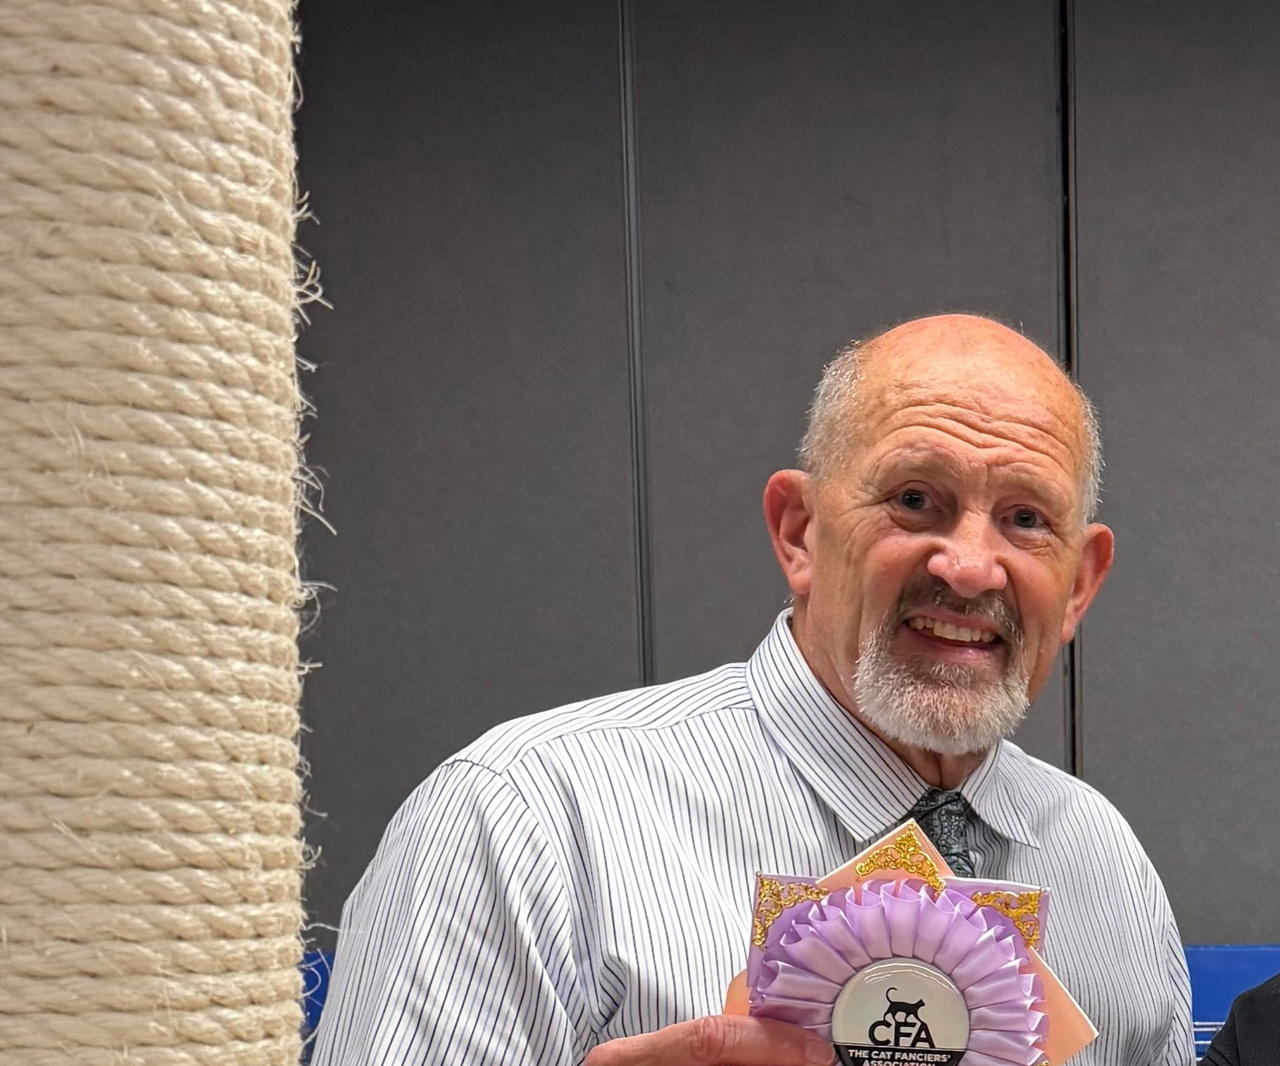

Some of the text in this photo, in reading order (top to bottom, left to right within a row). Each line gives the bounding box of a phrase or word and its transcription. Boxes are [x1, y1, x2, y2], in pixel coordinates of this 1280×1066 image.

[868, 1020, 936, 1049] CFA
[848, 1049, 951, 1062] THE CAT FANCIERS'
